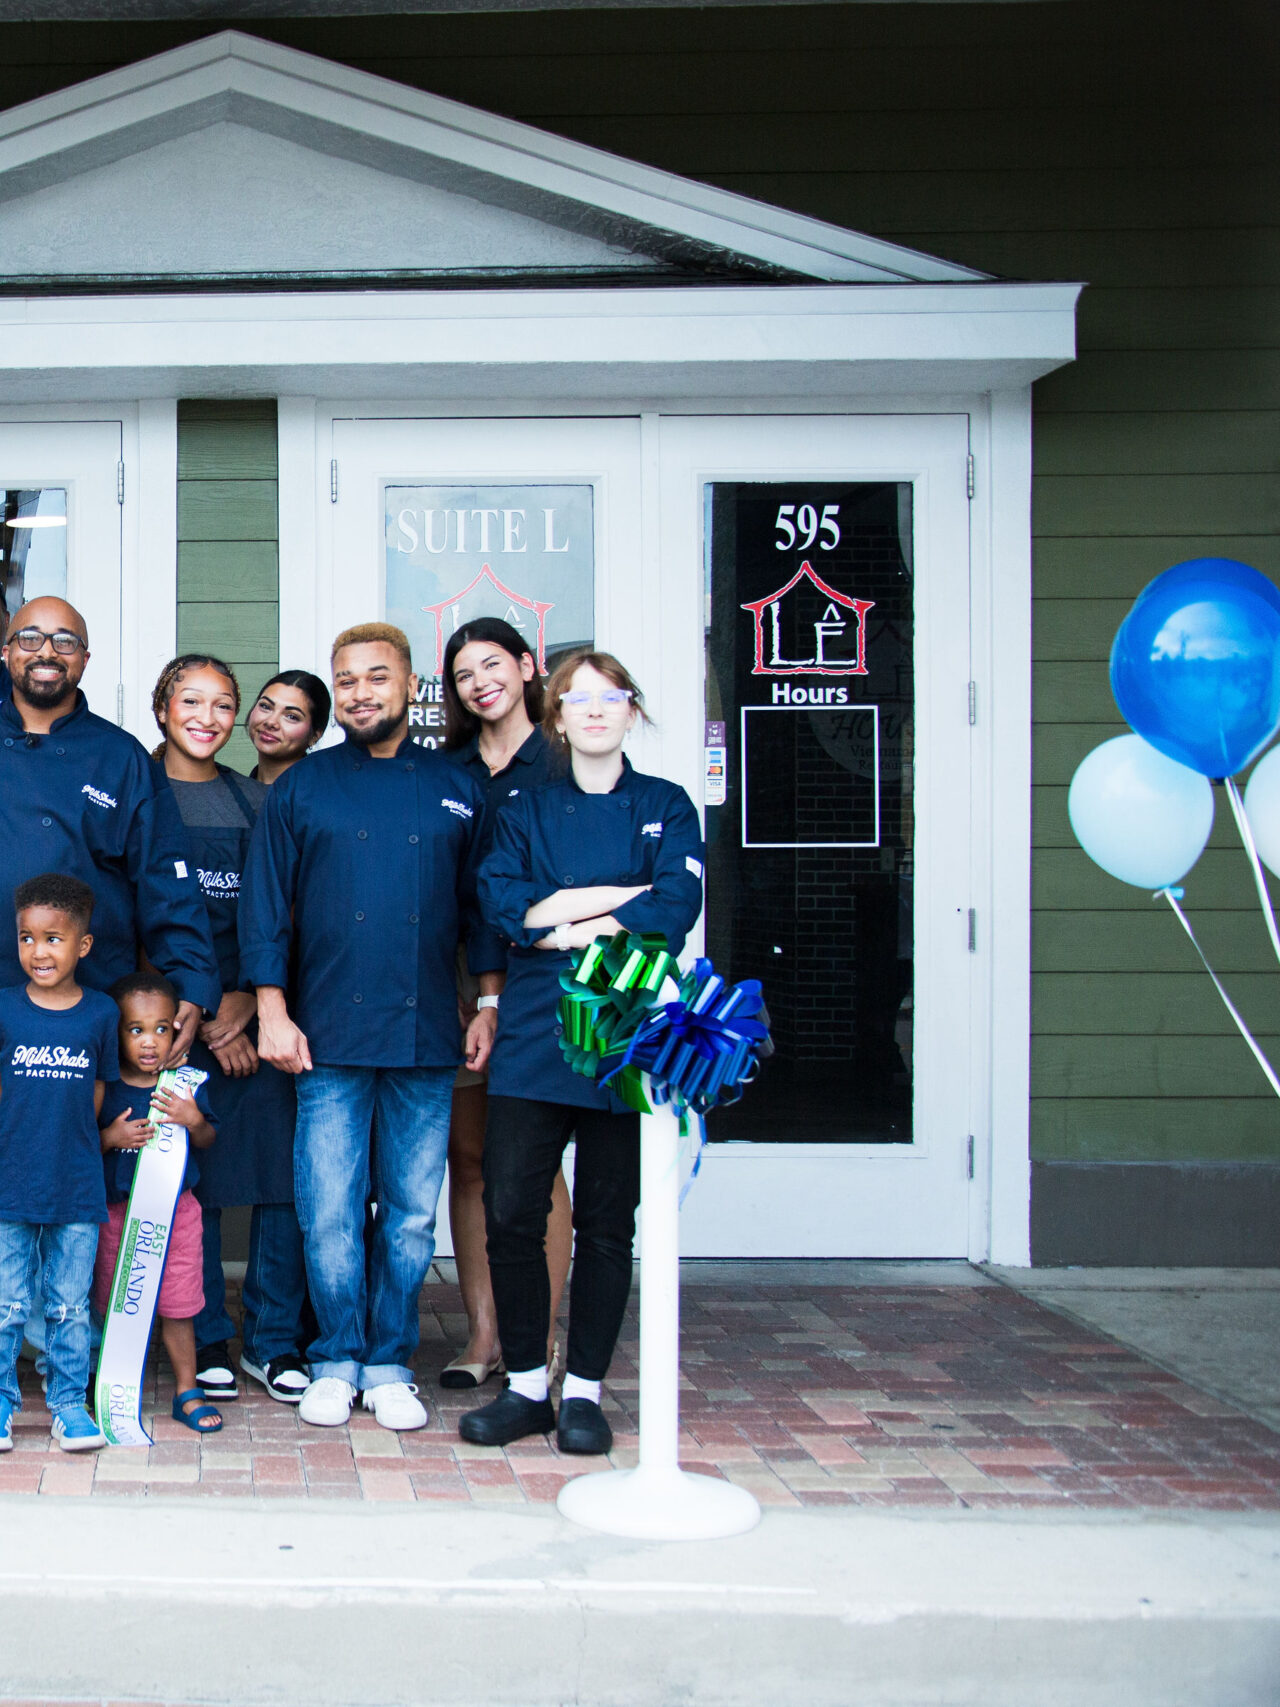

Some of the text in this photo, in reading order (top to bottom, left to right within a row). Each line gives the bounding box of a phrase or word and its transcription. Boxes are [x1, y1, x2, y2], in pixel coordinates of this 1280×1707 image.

[397, 508, 569, 554] SUITE L
[775, 504, 841, 551] 595
[772, 683, 849, 704] Hours
[11, 1044, 90, 1069] MilkShake
[26, 1069, 73, 1080] FACTORY
[150, 1223, 168, 1260] EAST
[123, 1220, 155, 1316] ORLANDO
[125, 1385, 137, 1421] EAST
